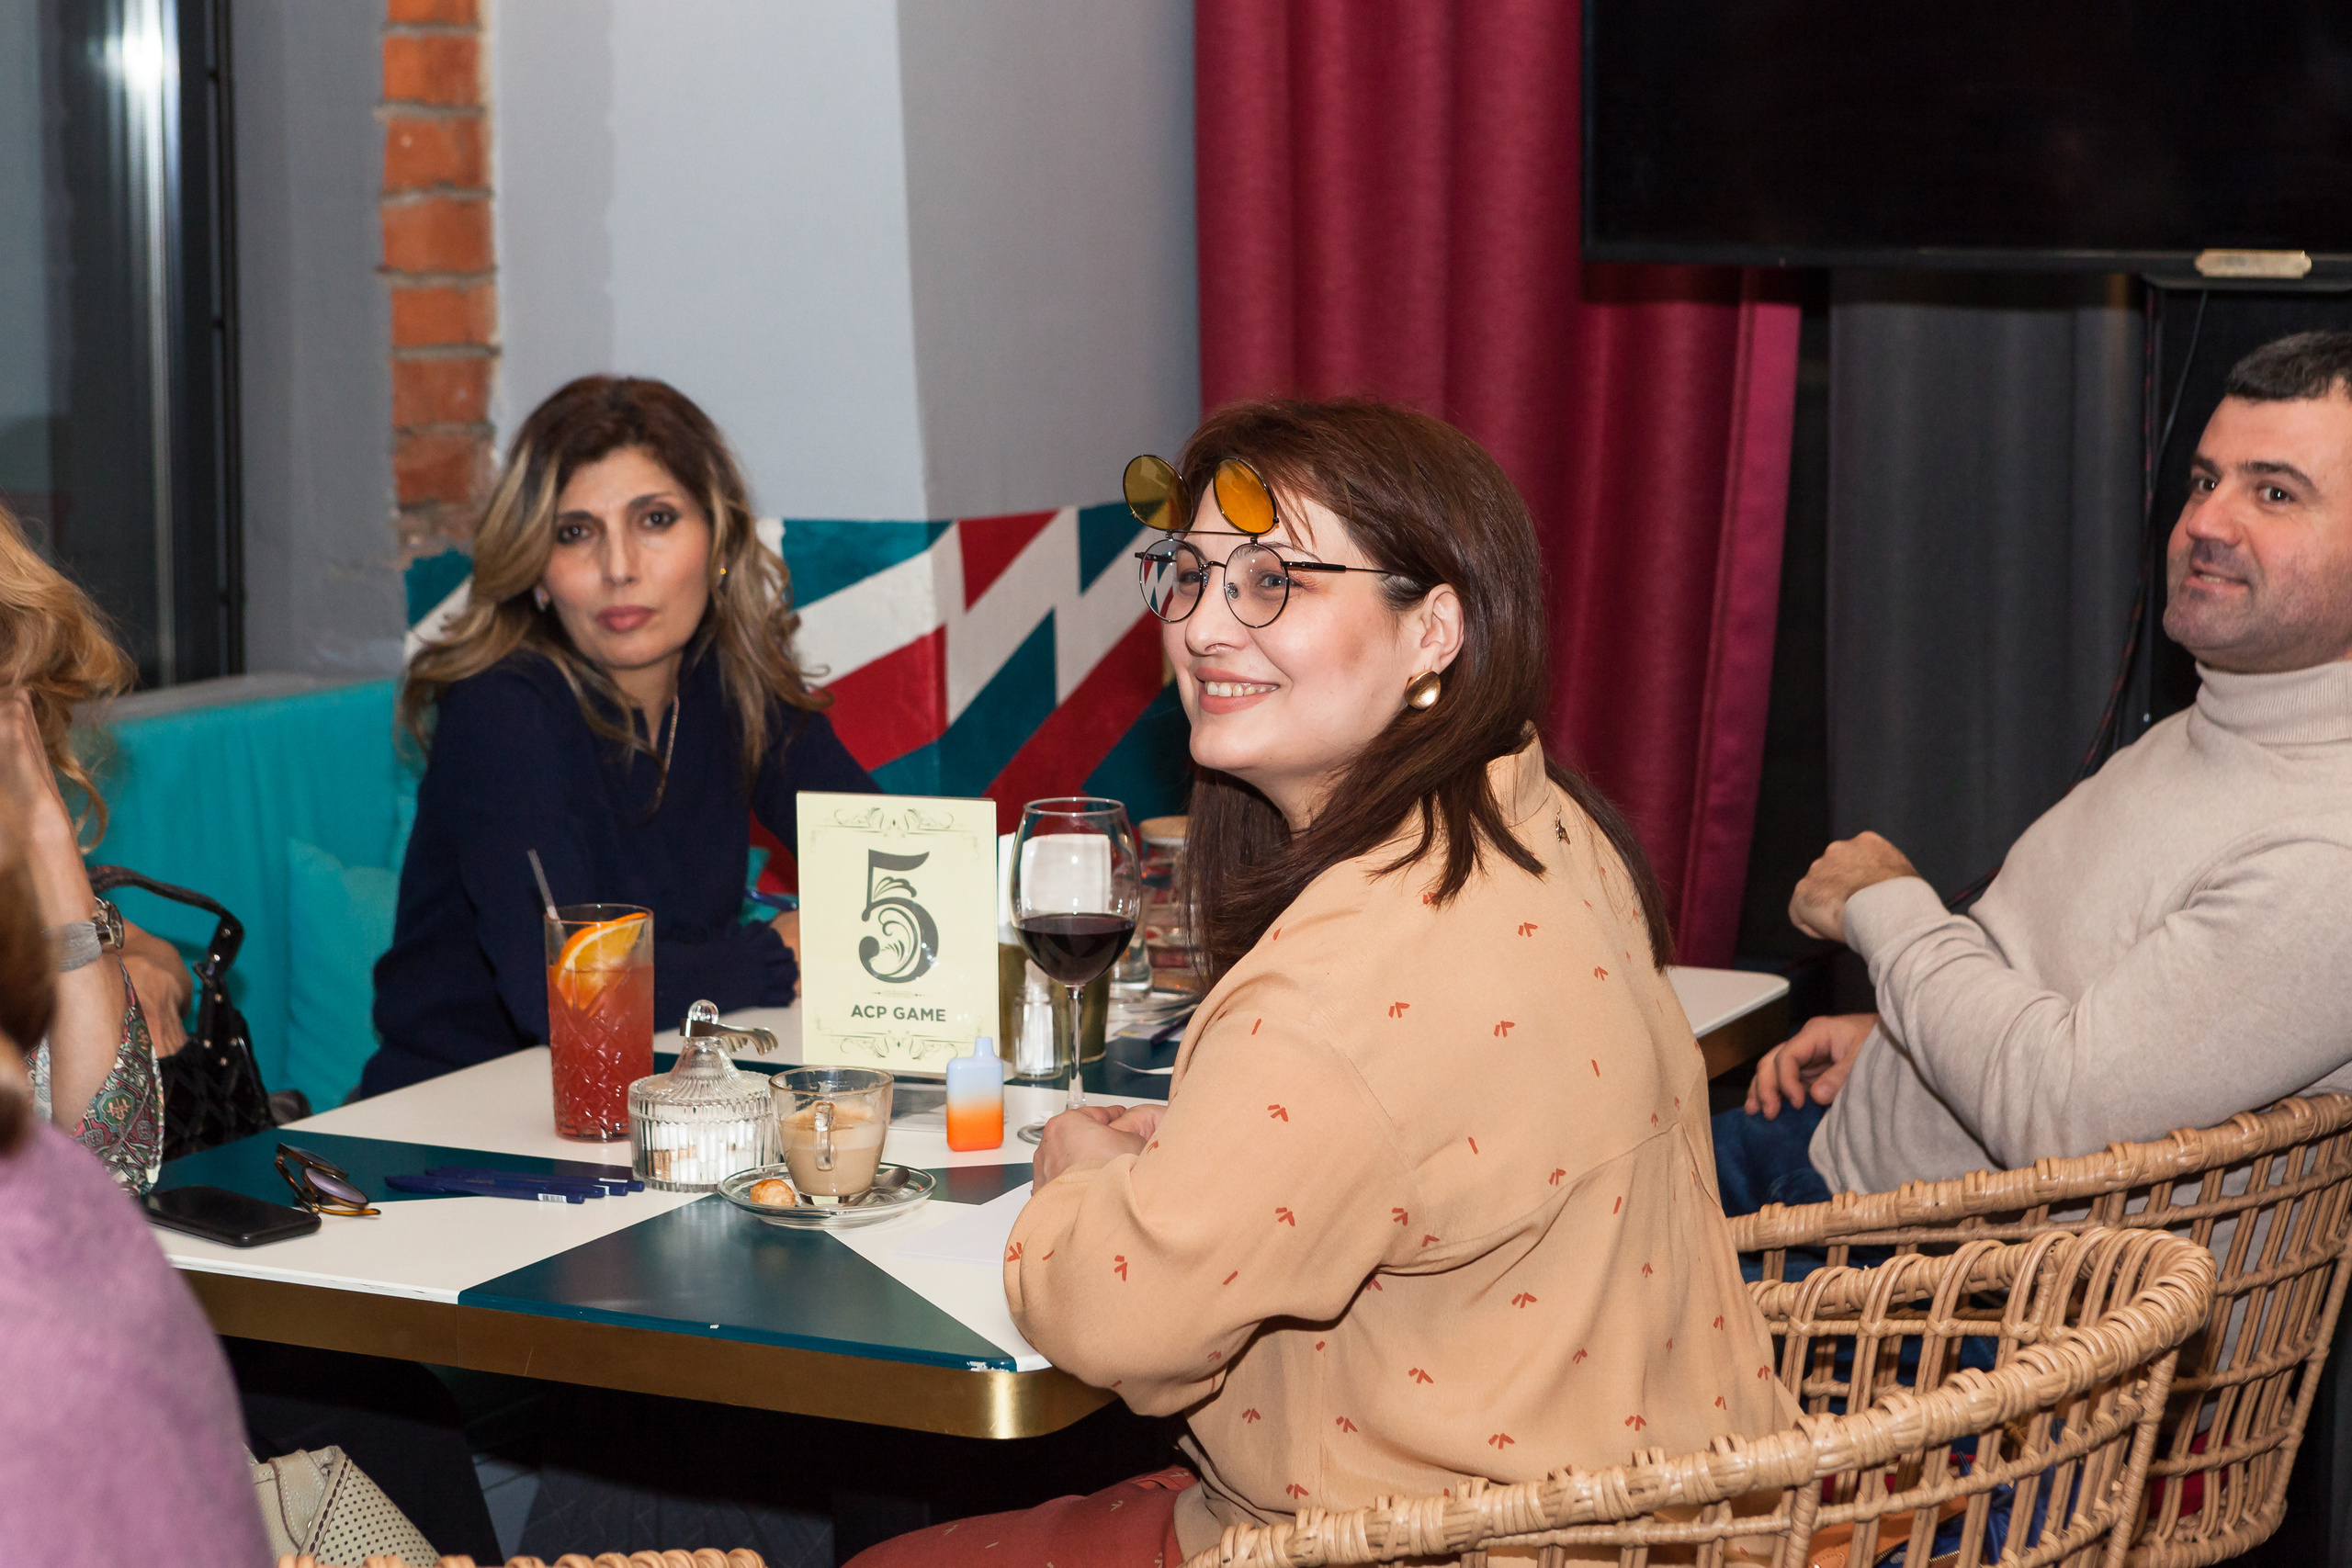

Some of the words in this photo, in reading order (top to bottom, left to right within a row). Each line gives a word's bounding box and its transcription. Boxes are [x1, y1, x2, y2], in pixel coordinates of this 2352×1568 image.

[859, 849, 939, 984] 5
[851, 1004, 888, 1019] ACP
[893, 1007, 946, 1021] GAME
